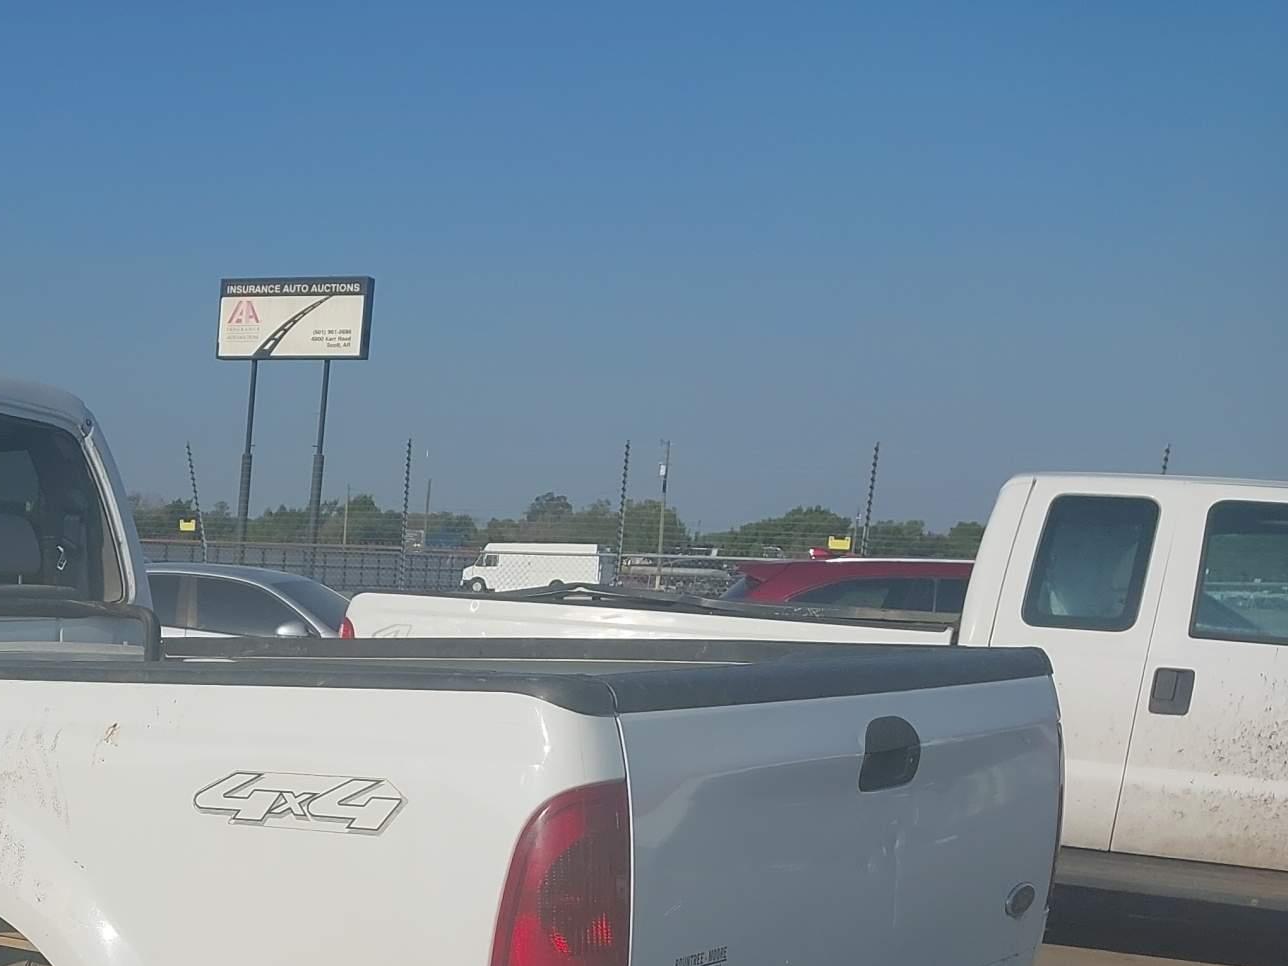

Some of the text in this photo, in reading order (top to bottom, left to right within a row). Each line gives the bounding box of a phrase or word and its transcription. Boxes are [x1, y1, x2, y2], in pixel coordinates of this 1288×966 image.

[226, 283, 361, 294] INSURANCE AUTO AUCTIONS
[193, 771, 405, 834] 4x4
